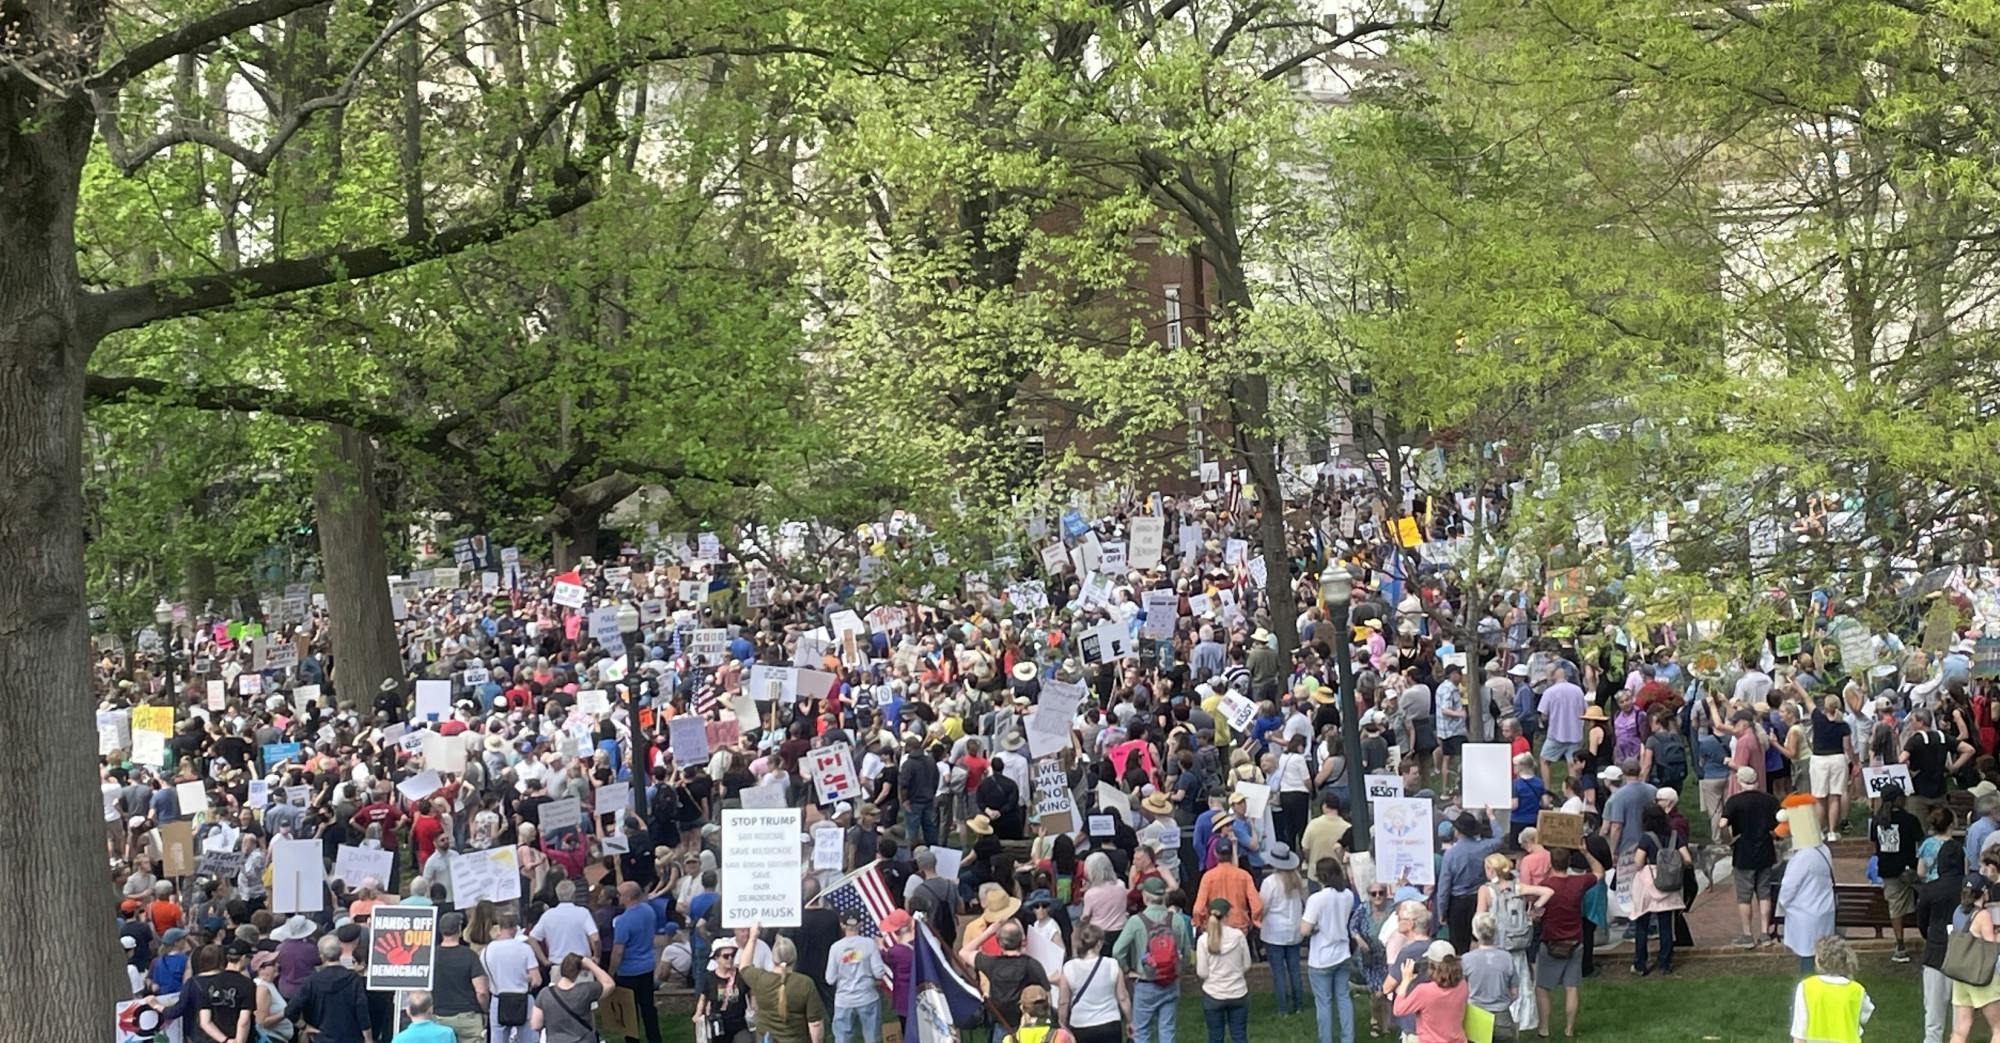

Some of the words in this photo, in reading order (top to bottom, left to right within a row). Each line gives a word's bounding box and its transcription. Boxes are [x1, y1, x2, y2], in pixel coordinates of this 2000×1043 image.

[1040, 762, 1058, 774] WE
[1370, 785, 1398, 797] RESIST
[731, 816, 758, 827] STOP
[760, 815, 797, 826] TRUMP
[752, 872, 770, 880] SAVE
[753, 883, 770, 891] OUR
[738, 894, 786, 902] DEMOCRACY
[729, 909, 758, 919] STOP
[761, 907, 794, 918] MUSK
[375, 916, 411, 930] HANDS
[413, 917, 433, 930] OFF
[404, 930, 432, 945] OUR
[371, 964, 430, 977] DEMOCRACY
